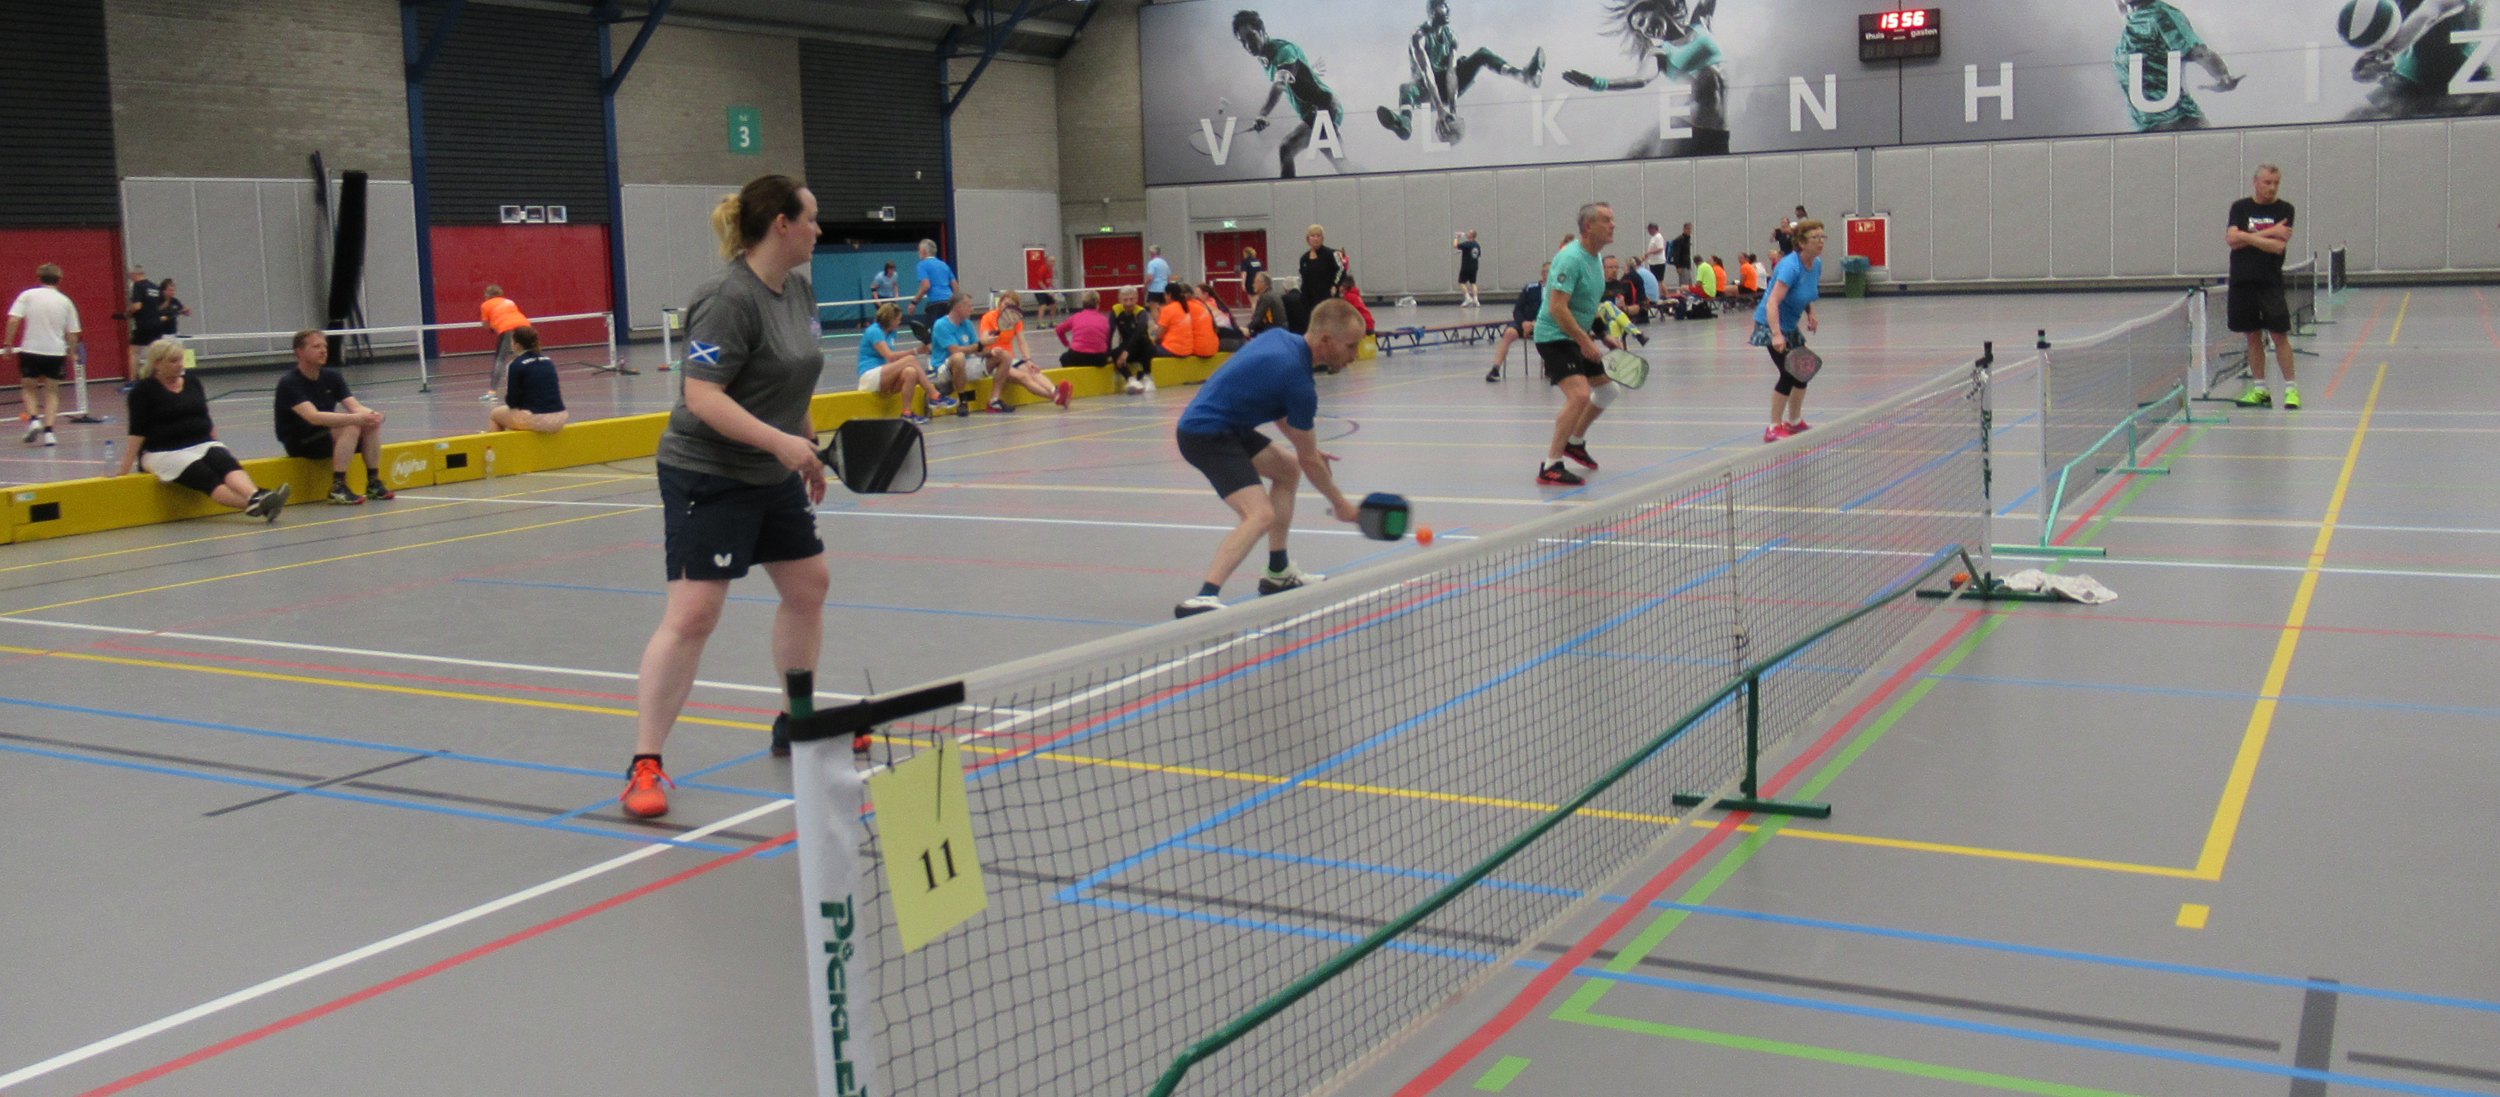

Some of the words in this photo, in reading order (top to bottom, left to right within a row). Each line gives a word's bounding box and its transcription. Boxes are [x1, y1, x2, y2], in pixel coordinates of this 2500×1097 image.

[1910, 28, 1938, 38] gasten
[739, 125, 750, 148] 3
[918, 838, 960, 893] 11
